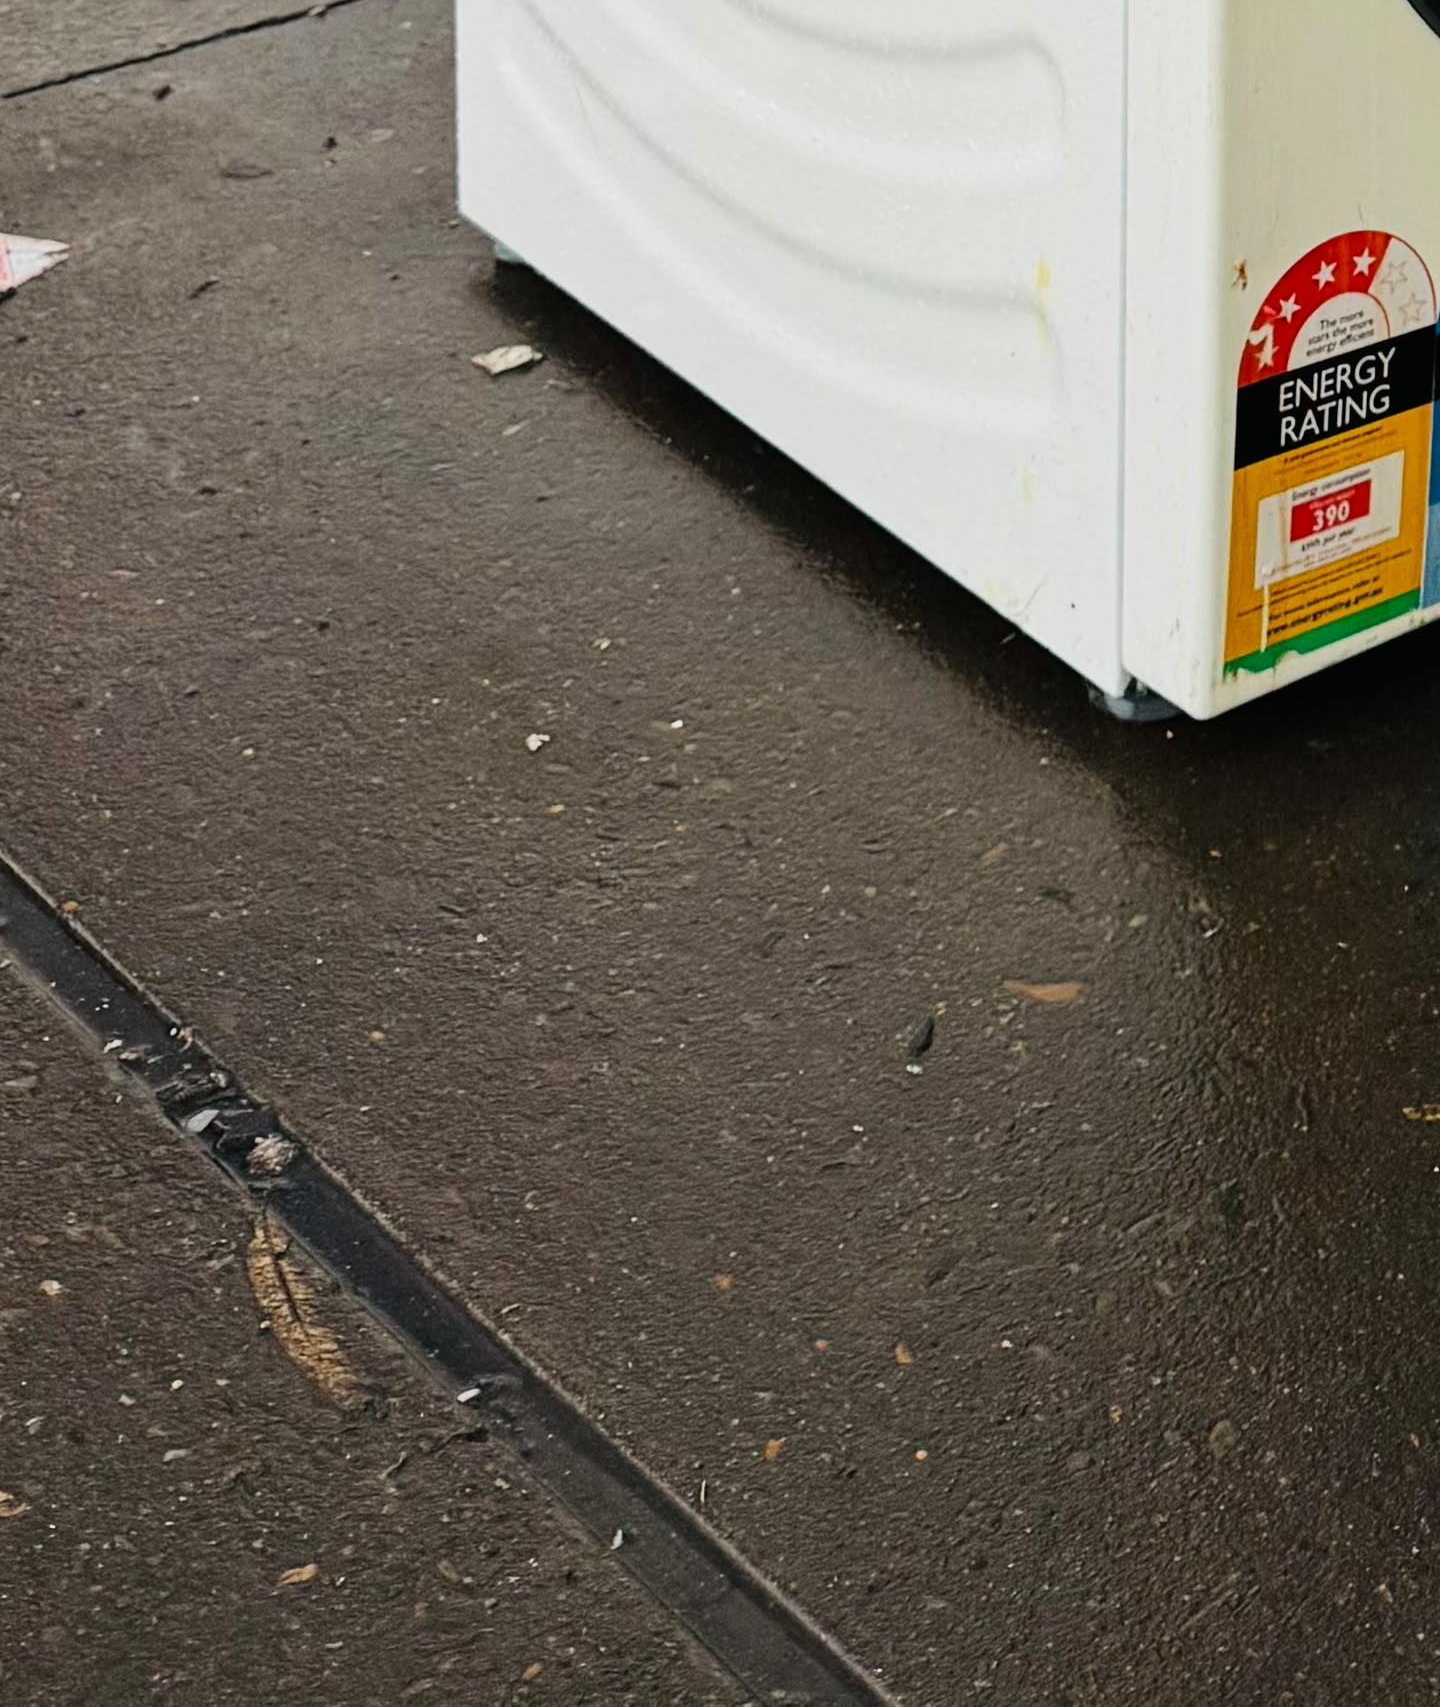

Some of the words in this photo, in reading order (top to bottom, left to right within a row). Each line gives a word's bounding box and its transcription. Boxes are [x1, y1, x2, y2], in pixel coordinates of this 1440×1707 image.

[1320, 316, 1336, 330] The
[1339, 310, 1364, 326] more
[1350, 318, 1374, 334] more
[1306, 340, 1336, 357] energy
[1279, 347, 1396, 412] ENERGY
[1280, 384, 1391, 447] RATING
[1312, 499, 1350, 532] 390
